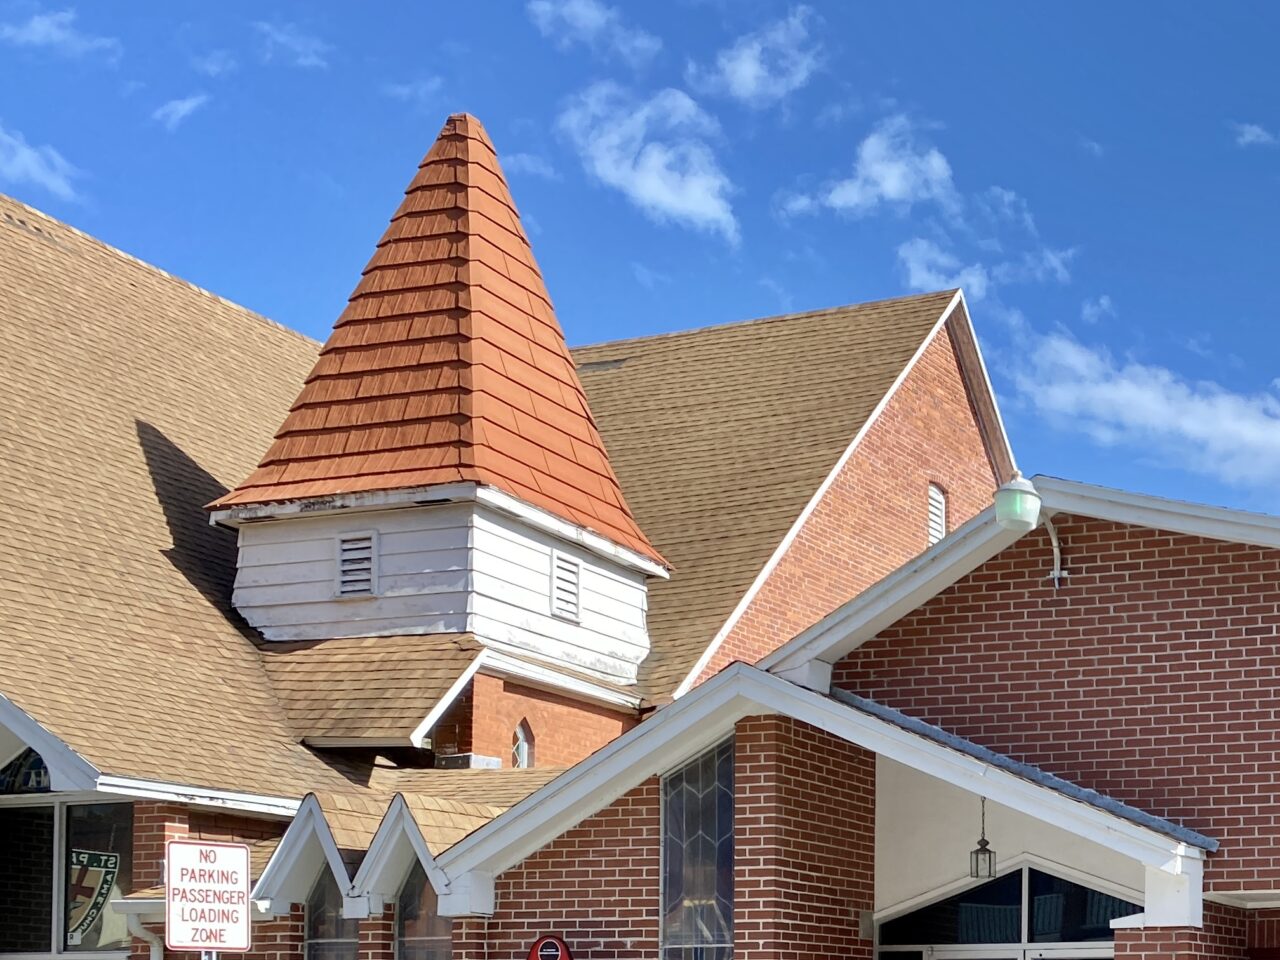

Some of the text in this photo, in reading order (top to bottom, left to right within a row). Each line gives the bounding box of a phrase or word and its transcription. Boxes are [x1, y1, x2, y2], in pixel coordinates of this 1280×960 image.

[199, 849, 217, 864] NO
[180, 867, 239, 885] PARKING
[172, 887, 246, 905] PASSENGER
[181, 907, 239, 924] LOADING
[191, 927, 227, 943] ZONE
